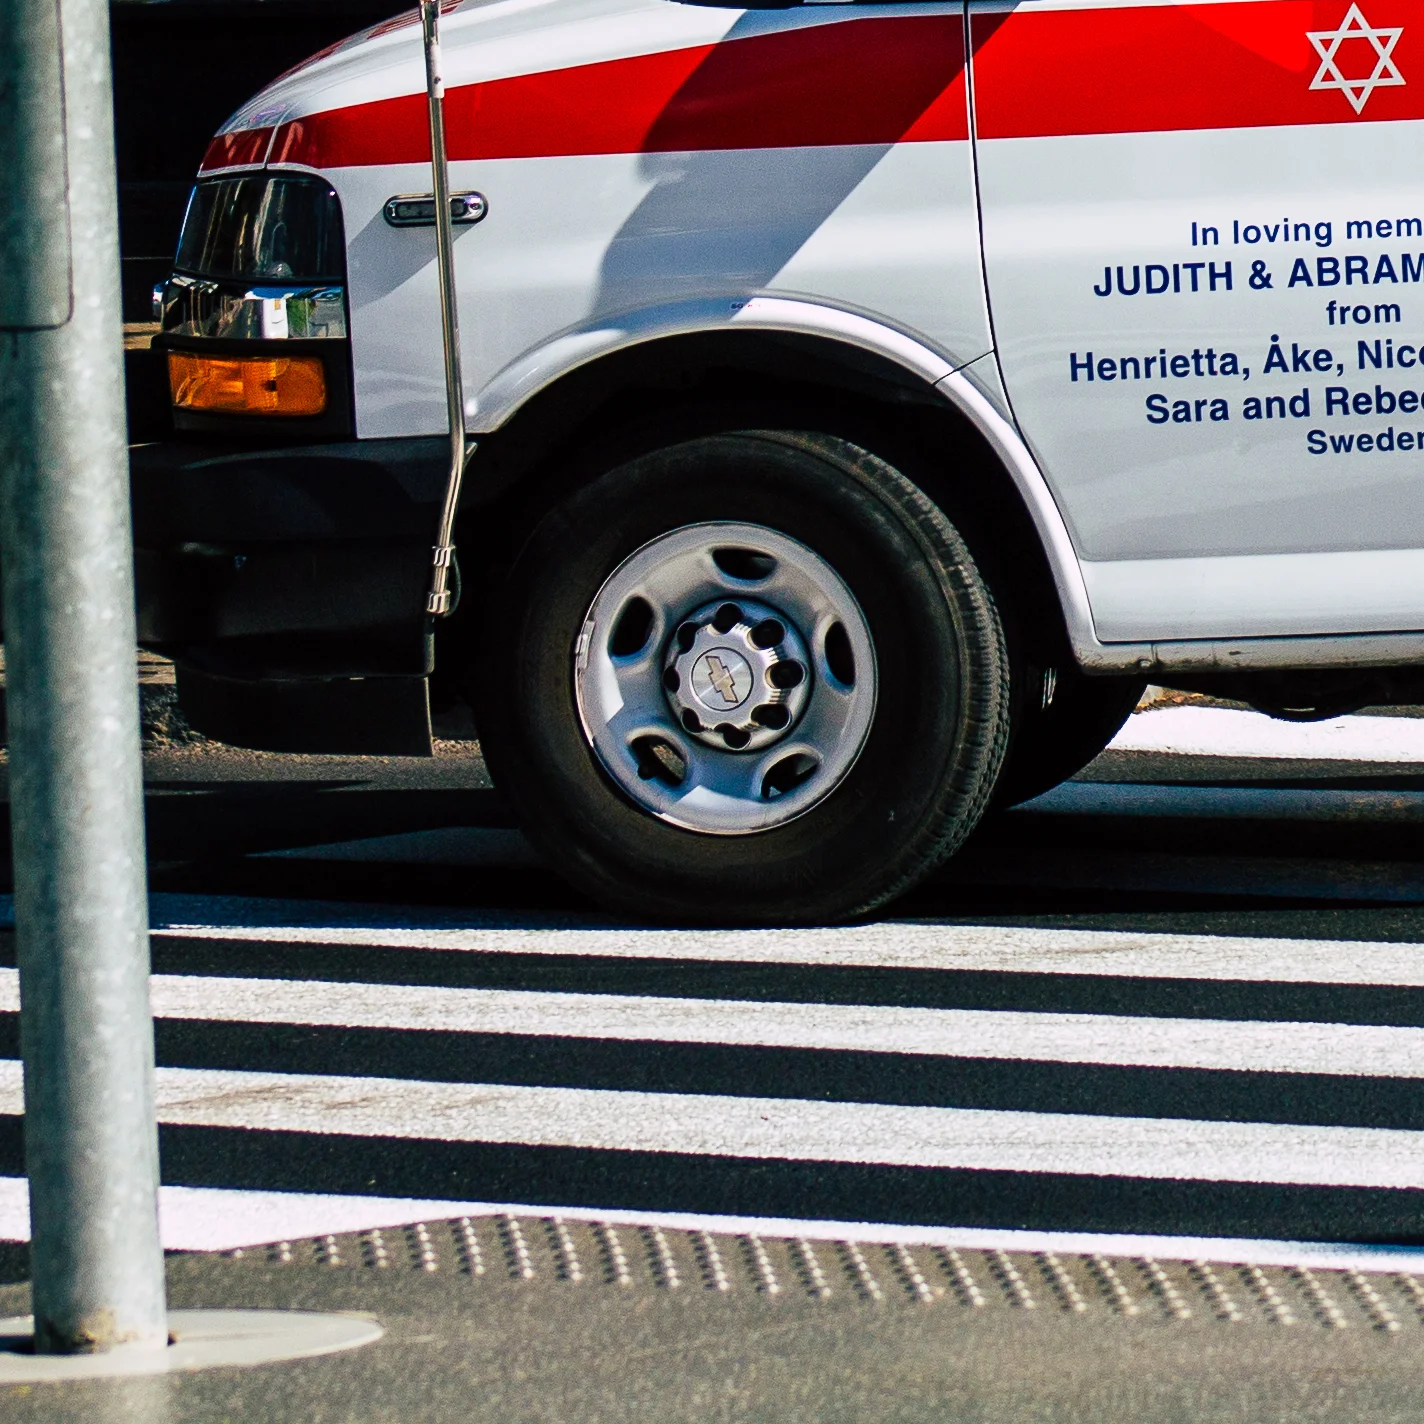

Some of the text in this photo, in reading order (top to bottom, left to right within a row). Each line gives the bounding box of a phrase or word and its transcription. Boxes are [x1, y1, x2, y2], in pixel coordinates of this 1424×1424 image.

[1190, 220, 1220, 247] In
[1233, 217, 1332, 248] loving
[1093, 260, 1233, 297] JUDITH
[1248, 259, 1274, 290] &
[1325, 299, 1401, 326] from
[1069, 348, 1250, 382] Henrietta,
[1262, 333, 1344, 377] Åke,
[1145, 393, 1230, 424] Sara
[1242, 387, 1311, 420] and
